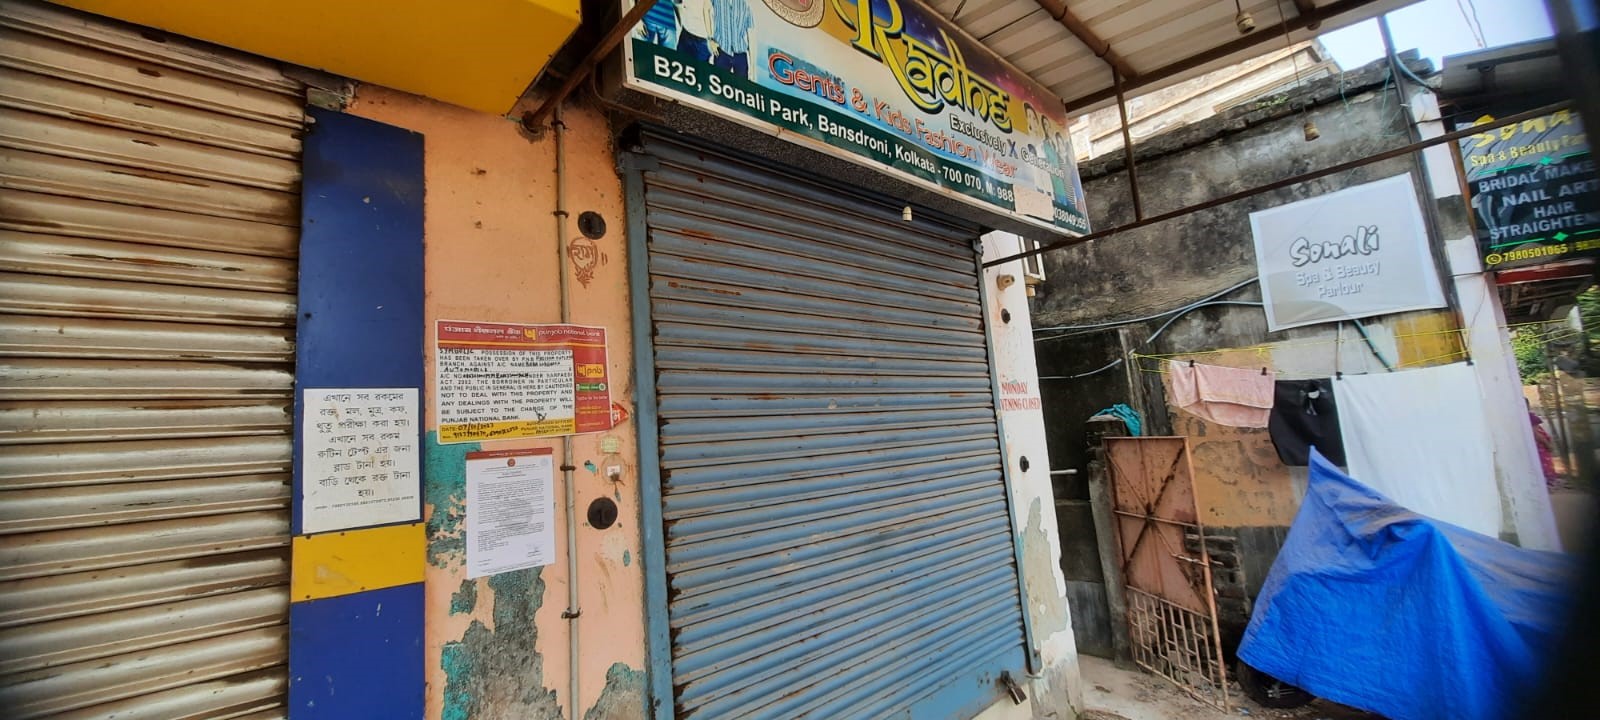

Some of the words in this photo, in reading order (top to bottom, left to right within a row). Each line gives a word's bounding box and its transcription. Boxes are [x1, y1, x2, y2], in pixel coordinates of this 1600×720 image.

[768, 52, 846, 104] Gents
[851, 87, 870, 116] &
[873, 97, 912, 135] Kids
[915, 118, 976, 162] Fashion
[654, 55, 702, 91] B25,
[709, 74, 765, 112] Sonali
[770, 100, 813, 130] Park,
[818, 114, 892, 158] Bansdroni,
[895, 143, 935, 173] Kolkata
[942, 166, 962, 183] 700
[964, 174, 984, 193] 070,
[997, 186, 1013, 202] 988
[950, 113, 1006, 157] Exclusively
[1006, 138, 1018, 160] X
[1478, 170, 1541, 194] BRIDAL
[1502, 189, 1552, 208] NAIL
[1533, 201, 1576, 219] HAIR
[1289, 225, 1380, 267] Sonali
[1296, 271, 1320, 287] Spa
[1323, 268, 1334, 282] &
[1336, 261, 1381, 280] Beauty
[1318, 280, 1364, 299] Parlour
[586, 367, 603, 376] pnb
[1001, 381, 1027, 394] MONDAY
[323, 393, 351, 402] এখানে
[356, 393, 369, 401] সব
[374, 393, 404, 401] রকমের
[372, 420, 389, 428] করা
[328, 435, 356, 443] এখানে
[380, 432, 400, 440] রকম
[356, 460, 374, 469] টানা
[345, 475, 366, 485] থেকে
[393, 470, 410, 479] টানা
